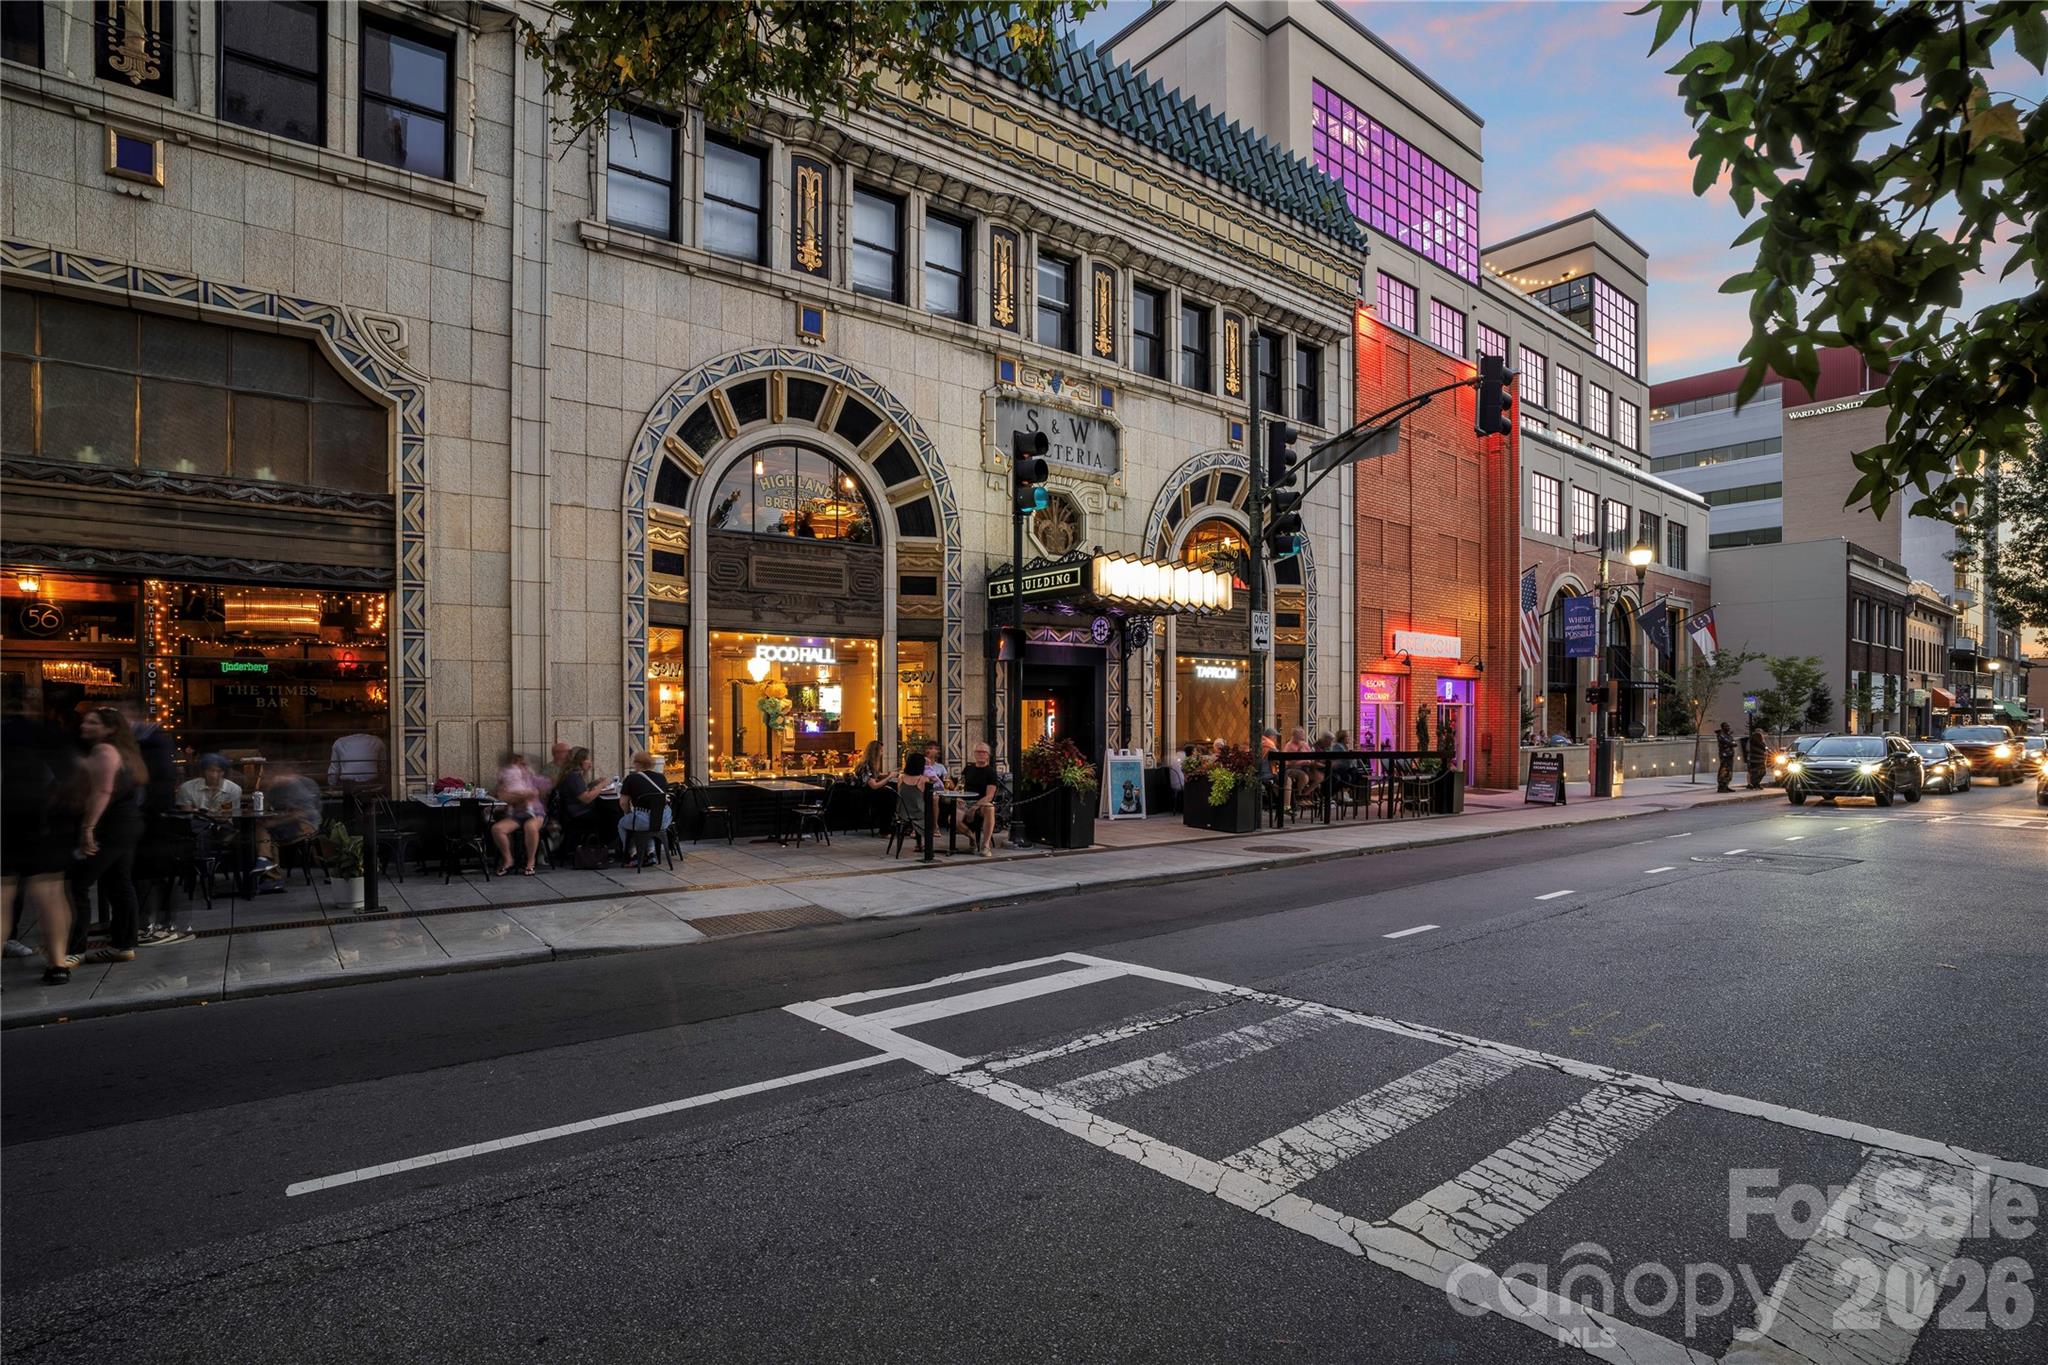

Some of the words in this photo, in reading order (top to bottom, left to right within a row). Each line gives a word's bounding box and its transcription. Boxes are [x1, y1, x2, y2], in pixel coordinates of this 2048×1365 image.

[1789, 409, 1815, 420] WARD
[1815, 405, 1836, 416] AND
[1836, 399, 1866, 411] SMIT
[1026, 409, 1039, 433] S
[1051, 418, 1060, 435] &
[1068, 418, 1091, 444] W
[759, 474, 834, 499] HIGHLAND
[765, 496, 827, 513] BREWING
[28, 609, 60, 629] 56
[1254, 614, 1269, 625] ONE
[1568, 615, 1592, 624] WHERE
[1254, 625, 1269, 635] WAY
[756, 644, 799, 662] FOOD
[799, 647, 836, 663] HALL
[221, 661, 269, 673] Underberg
[651, 661, 680, 677] S&W
[1195, 666, 1237, 679] TAPROOM
[901, 670, 935, 683] S&W
[147, 662, 157, 714] COFFEE
[225, 684, 260, 696] THE
[266, 684, 318, 696] TIMES
[256, 697, 290, 708] BAR
